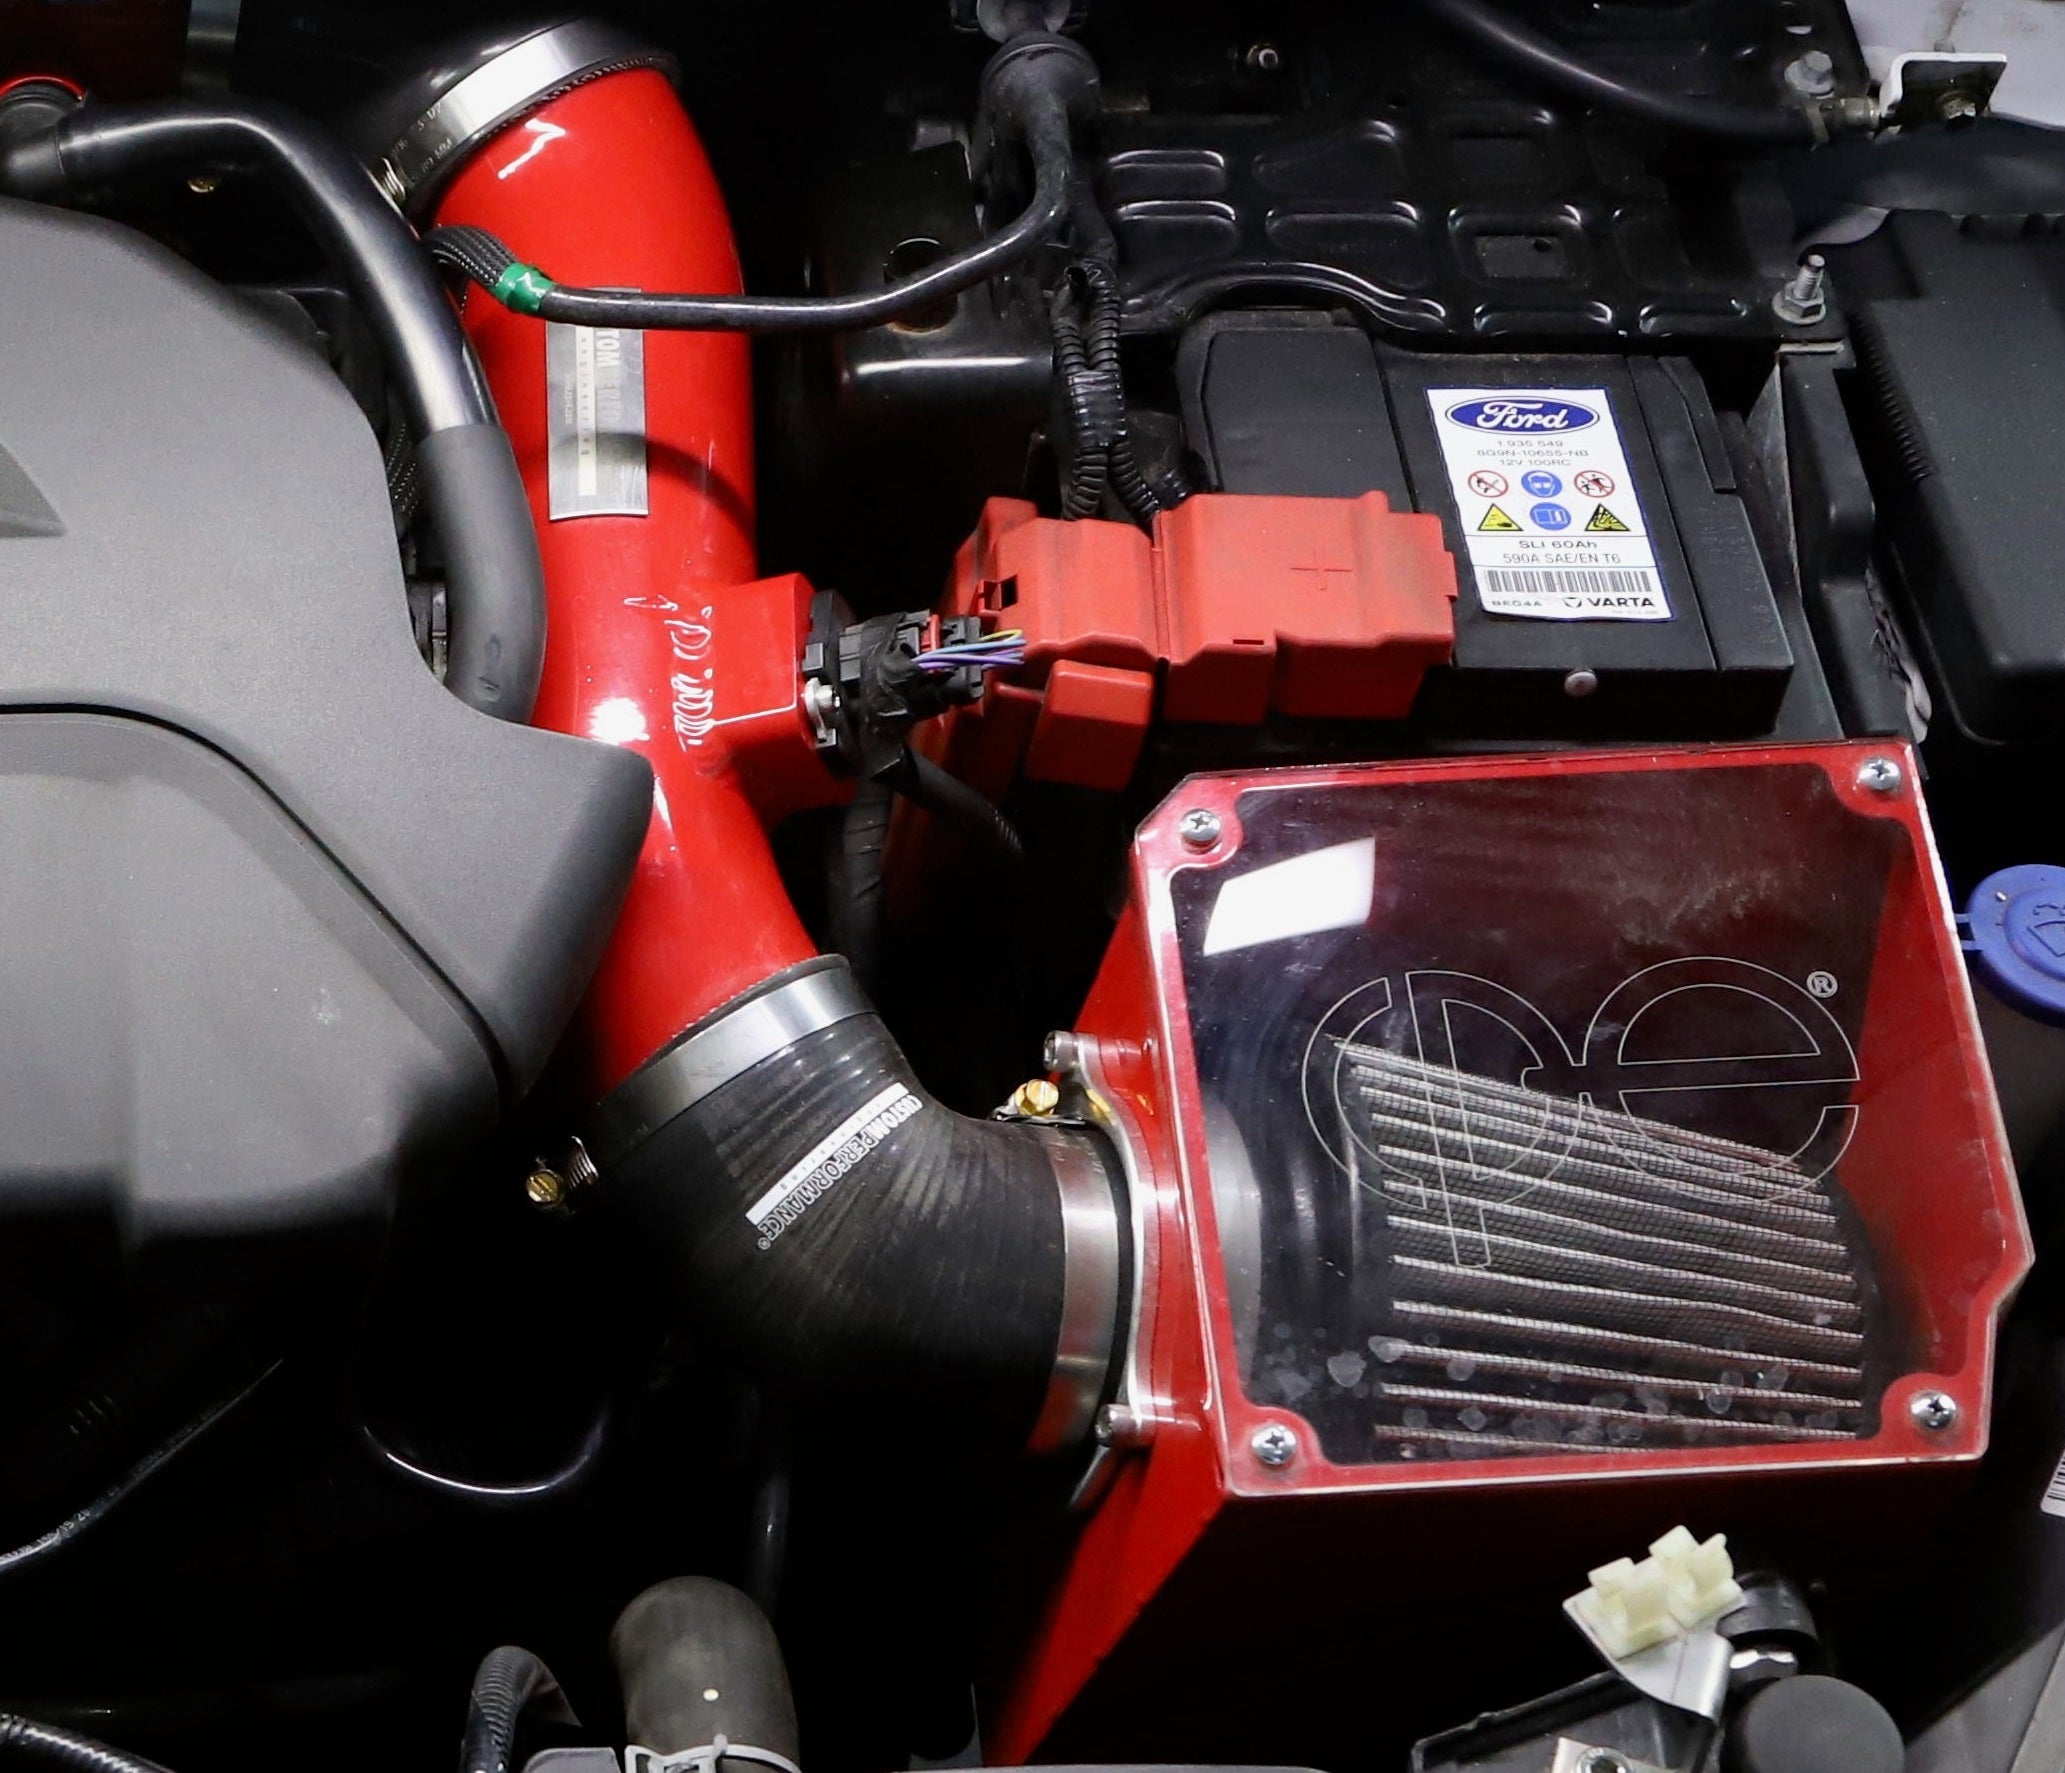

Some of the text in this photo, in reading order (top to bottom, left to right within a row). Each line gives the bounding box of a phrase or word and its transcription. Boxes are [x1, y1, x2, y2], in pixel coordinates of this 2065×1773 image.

[1476, 401, 1569, 428] Ford
[1518, 540, 1598, 549] SLI 60Ah
[1503, 553, 1621, 564] 590A SAE/EN T6
[1587, 597, 1655, 607] VARTA
